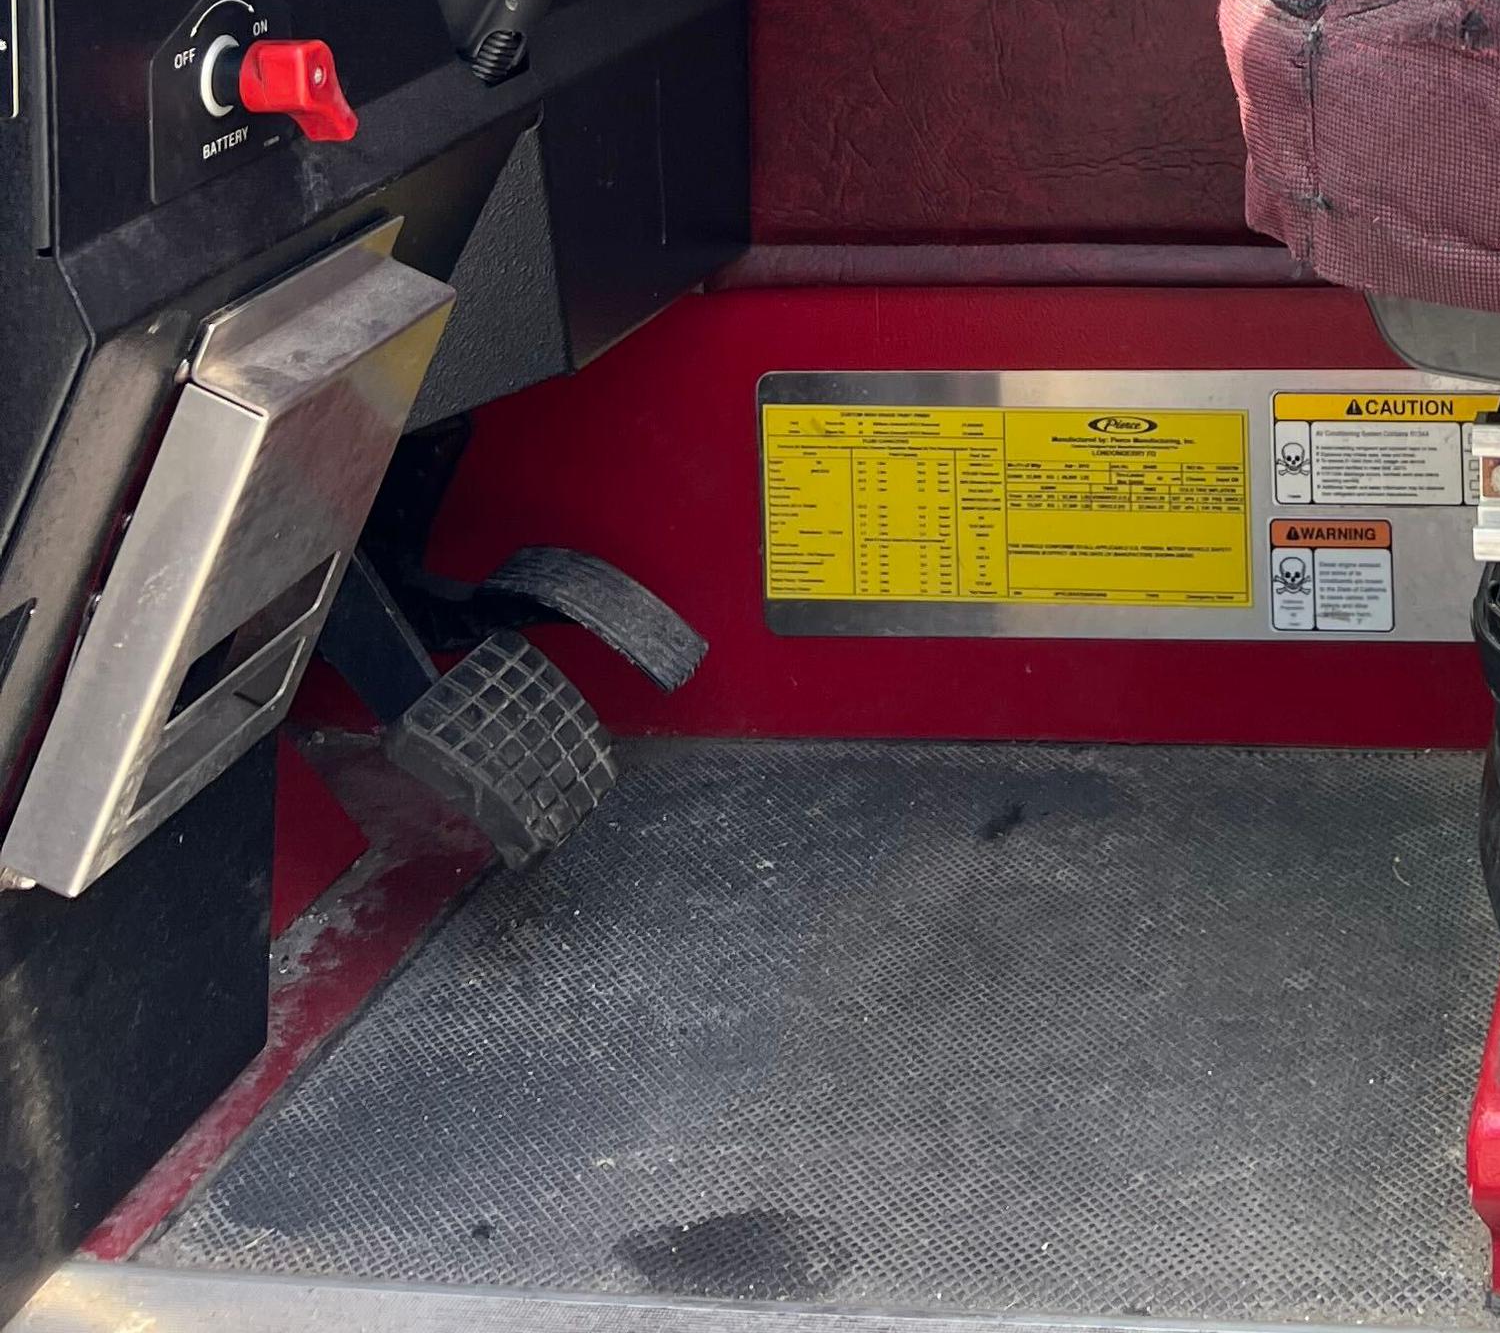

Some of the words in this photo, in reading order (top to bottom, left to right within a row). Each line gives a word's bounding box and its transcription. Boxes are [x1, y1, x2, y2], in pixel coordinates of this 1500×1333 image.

[252, 19, 268, 37] ON
[174, 47, 197, 69] OFF
[202, 126, 250, 160] BATTERY
[1365, 399, 1454, 416] CAUTION
[1103, 418, 1142, 433] Pierce
[1300, 527, 1377, 542] WARNING
